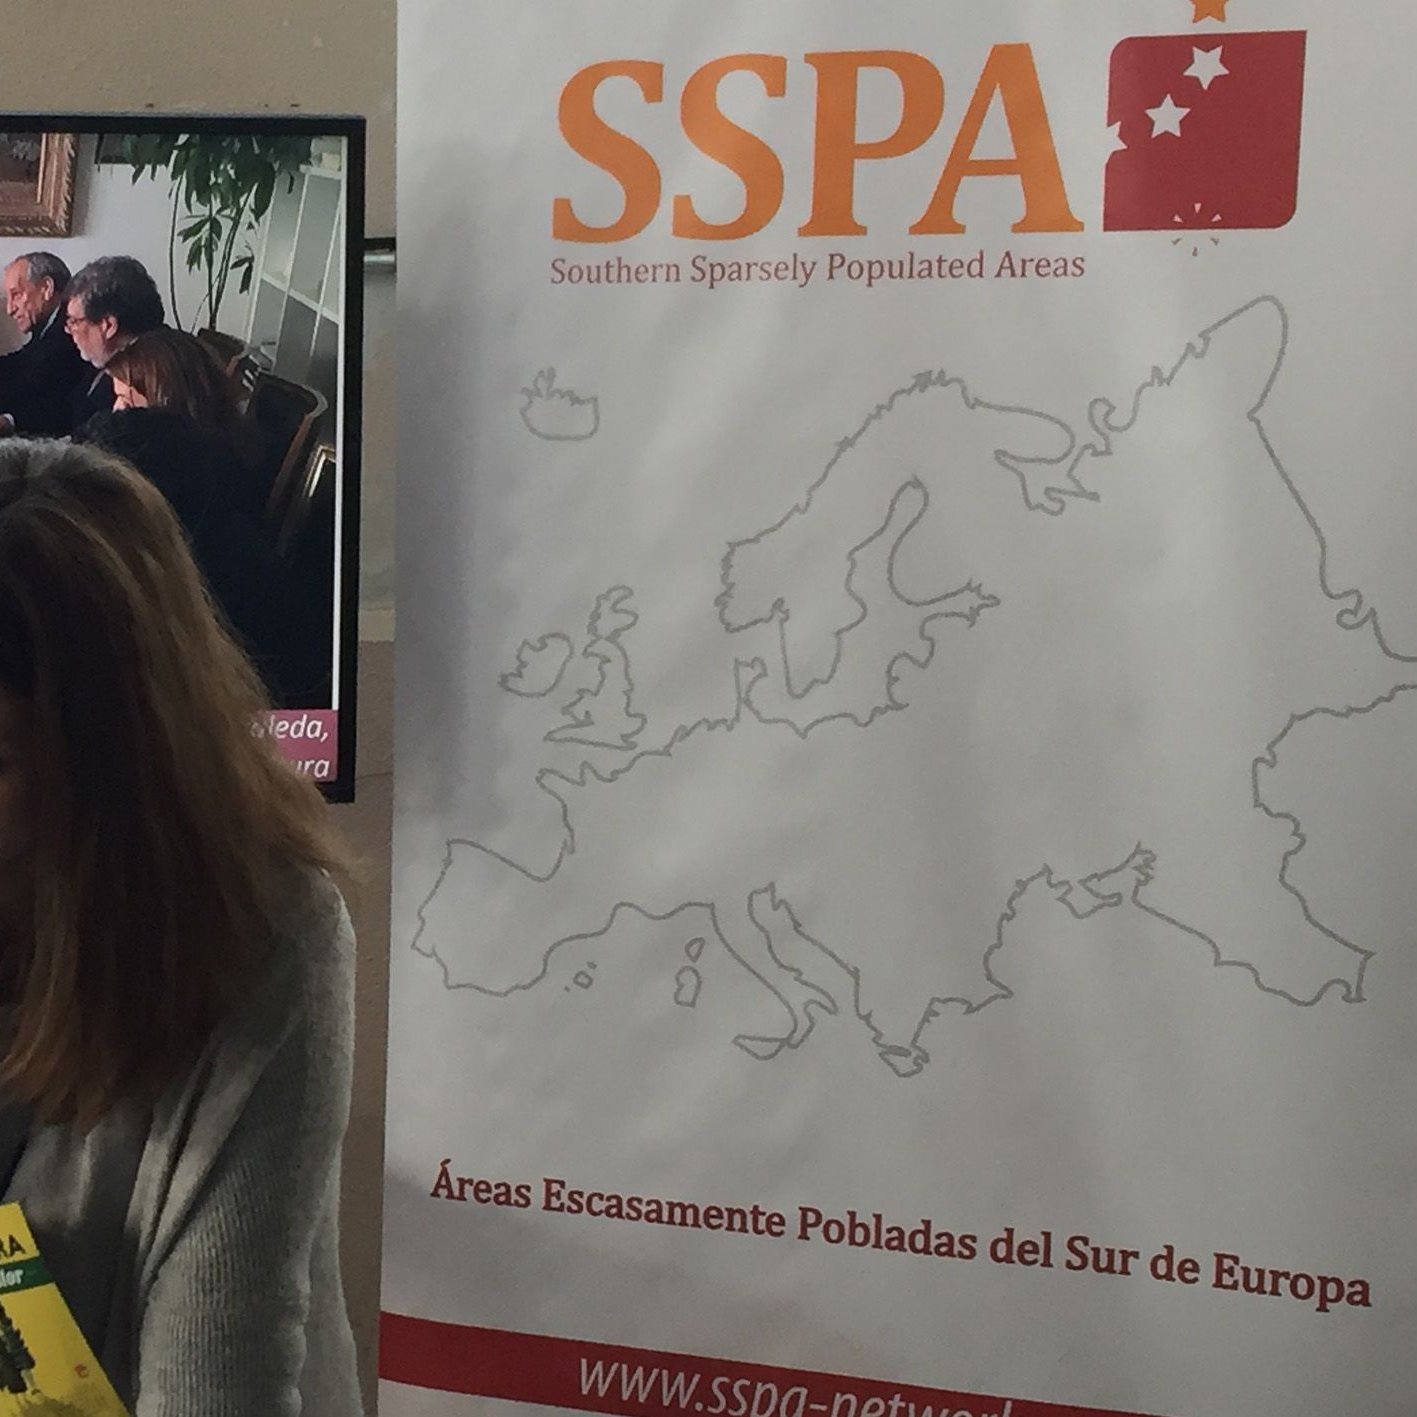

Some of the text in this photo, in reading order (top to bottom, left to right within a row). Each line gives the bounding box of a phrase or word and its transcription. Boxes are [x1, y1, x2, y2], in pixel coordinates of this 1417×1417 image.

[552, 42, 1086, 244] SSPA
[550, 250, 1086, 289] Southern Sparsely Populated Areas
[430, 1158, 1372, 1313] Áreas Escasamente Pobladas del Sur de Europa
